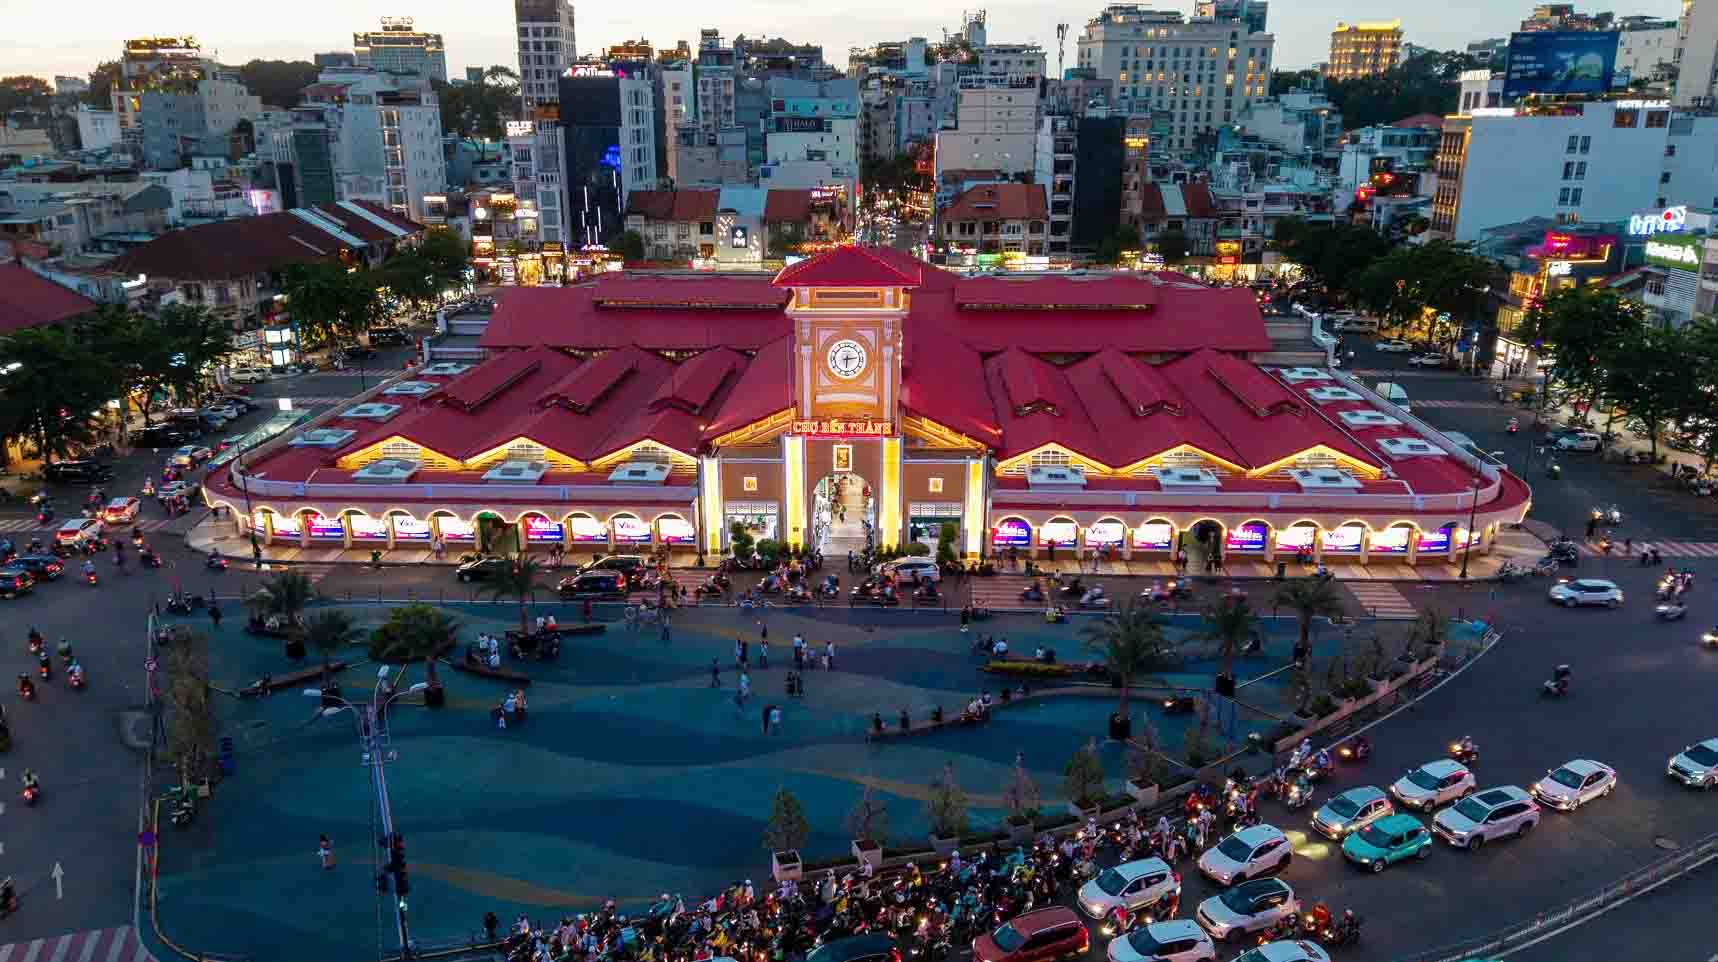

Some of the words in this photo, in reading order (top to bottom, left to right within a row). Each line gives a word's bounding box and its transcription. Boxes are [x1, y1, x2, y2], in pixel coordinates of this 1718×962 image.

[793, 421, 819, 435] CHỢ
[821, 418, 846, 433] BẾN
[848, 418, 892, 434] THÀNH
